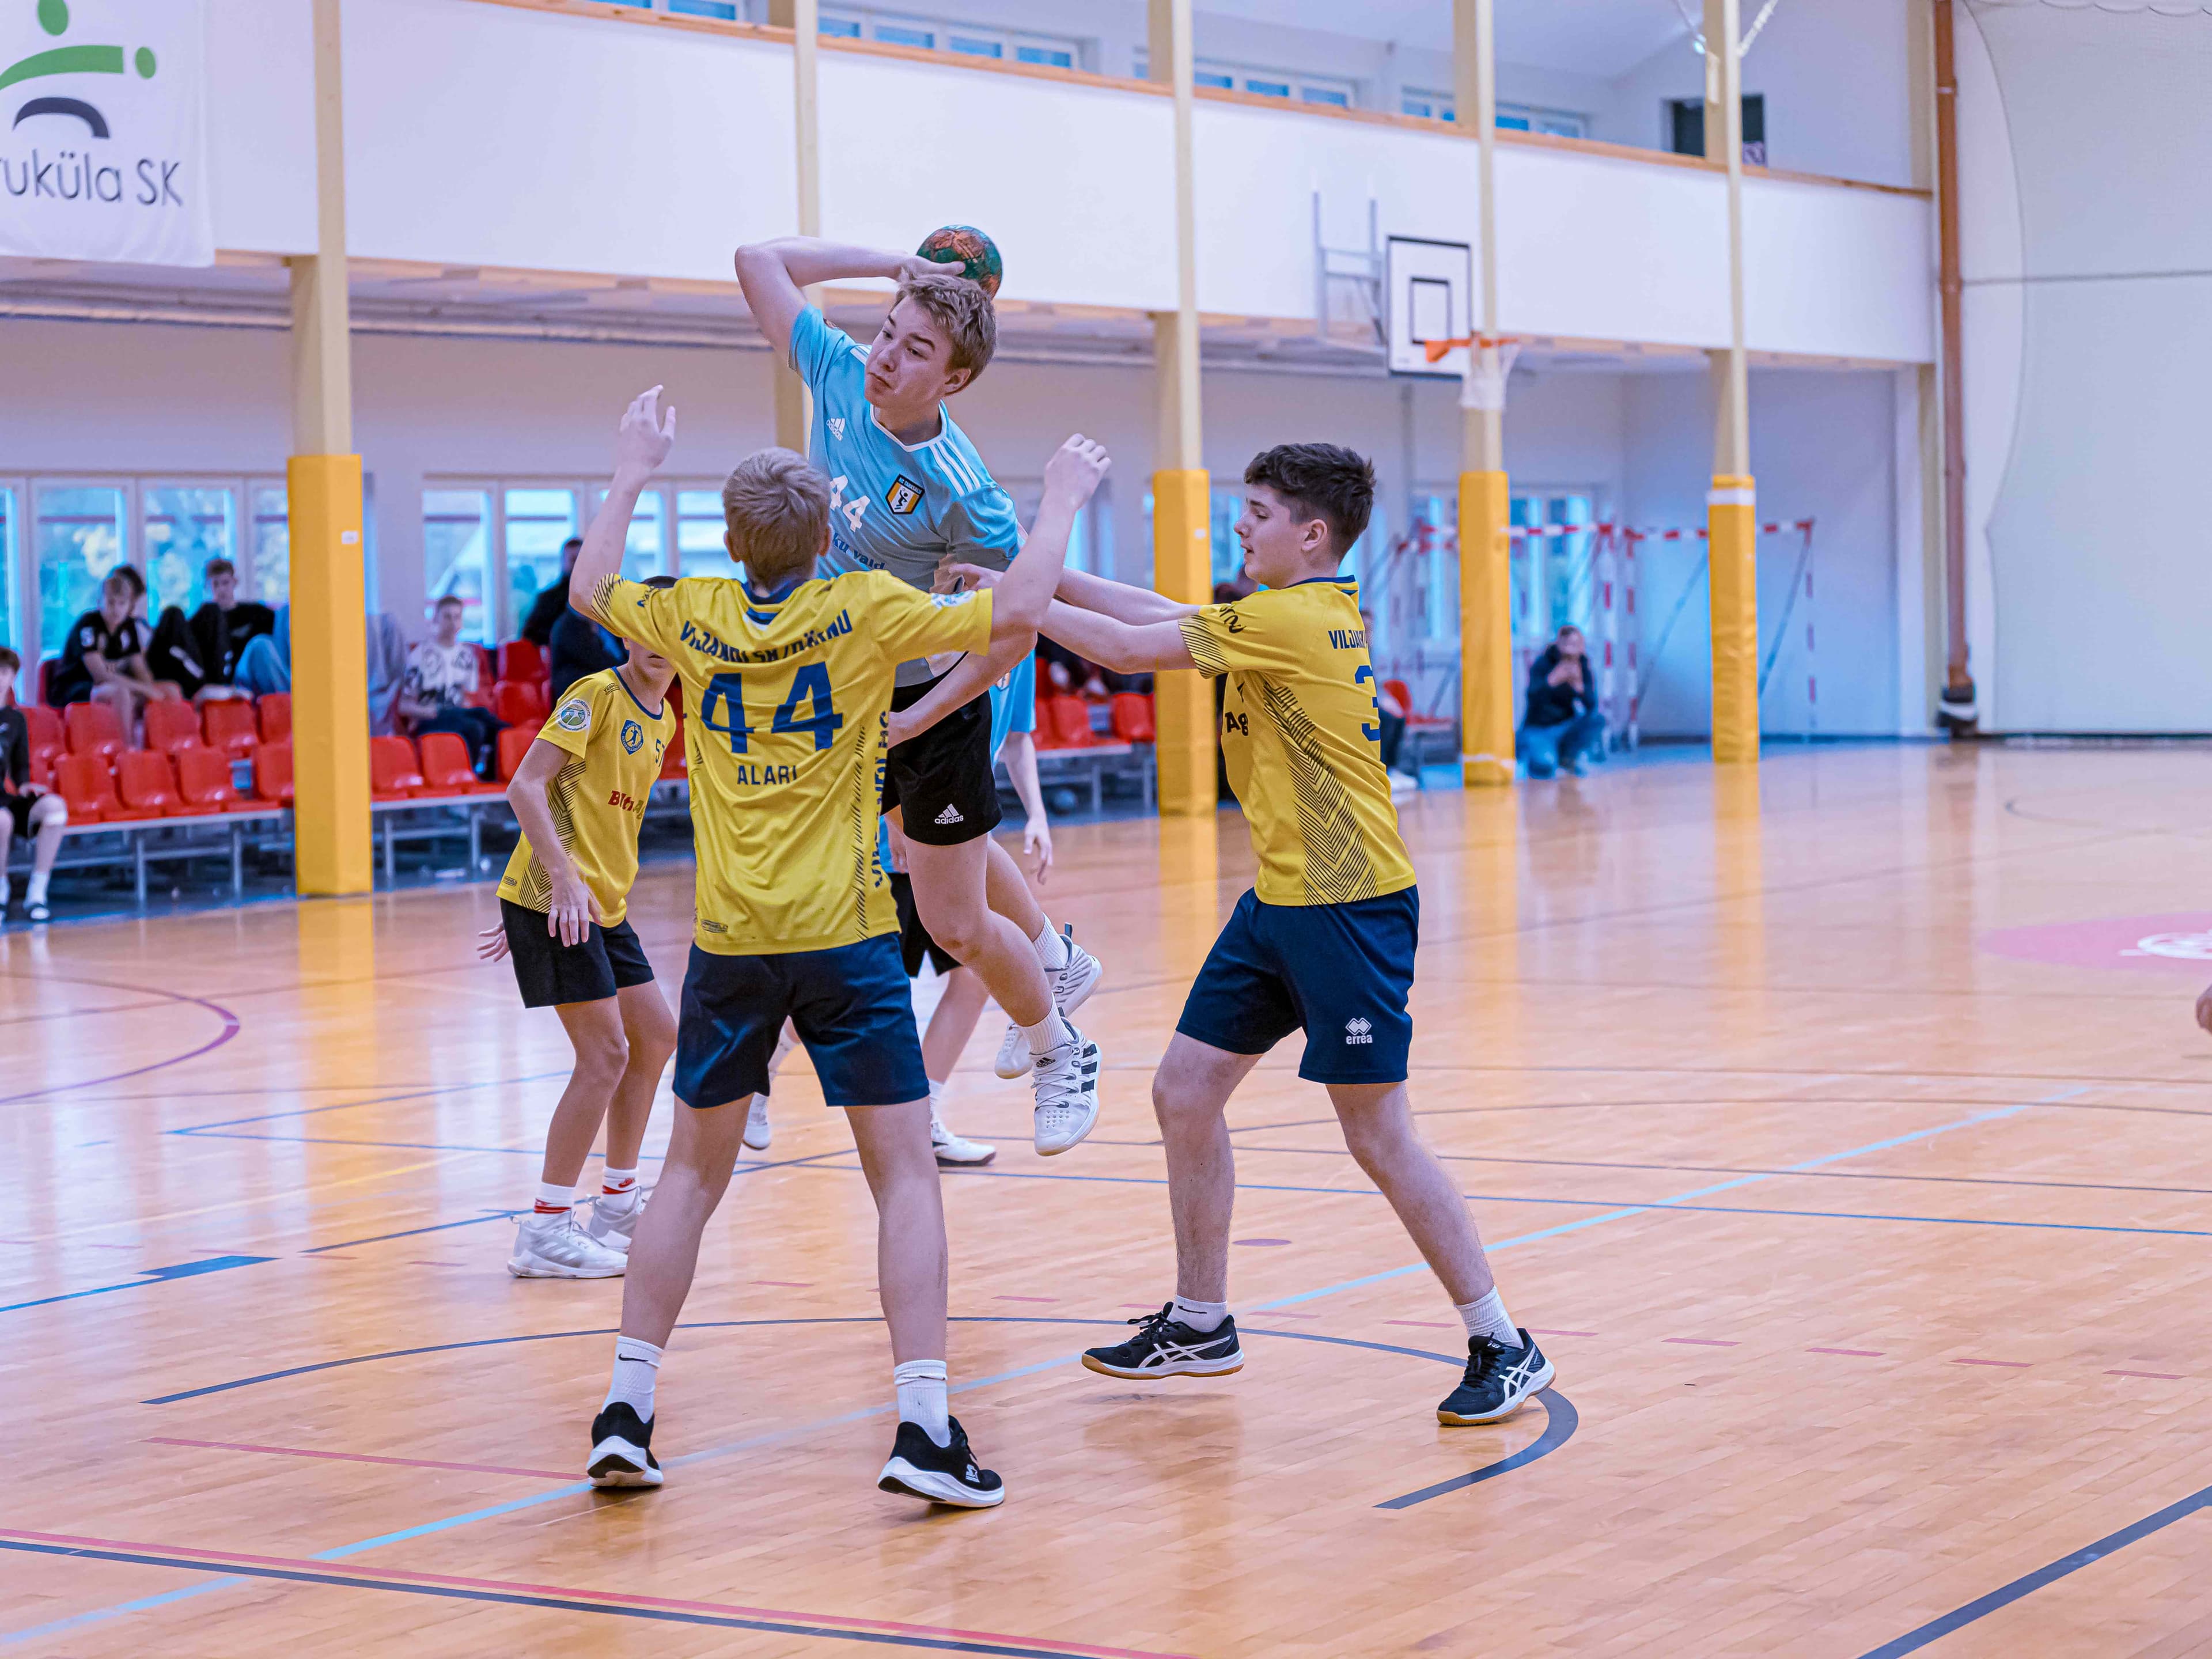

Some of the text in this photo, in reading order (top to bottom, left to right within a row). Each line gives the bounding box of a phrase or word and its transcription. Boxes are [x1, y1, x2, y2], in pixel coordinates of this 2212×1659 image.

[0, 149, 183, 207] uküla SK
[826, 419, 843, 441] adidas
[701, 661, 843, 753] 44
[737, 765, 797, 785] ALARI
[934, 815, 964, 824] adidas
[1346, 1035, 1373, 1044] errea
